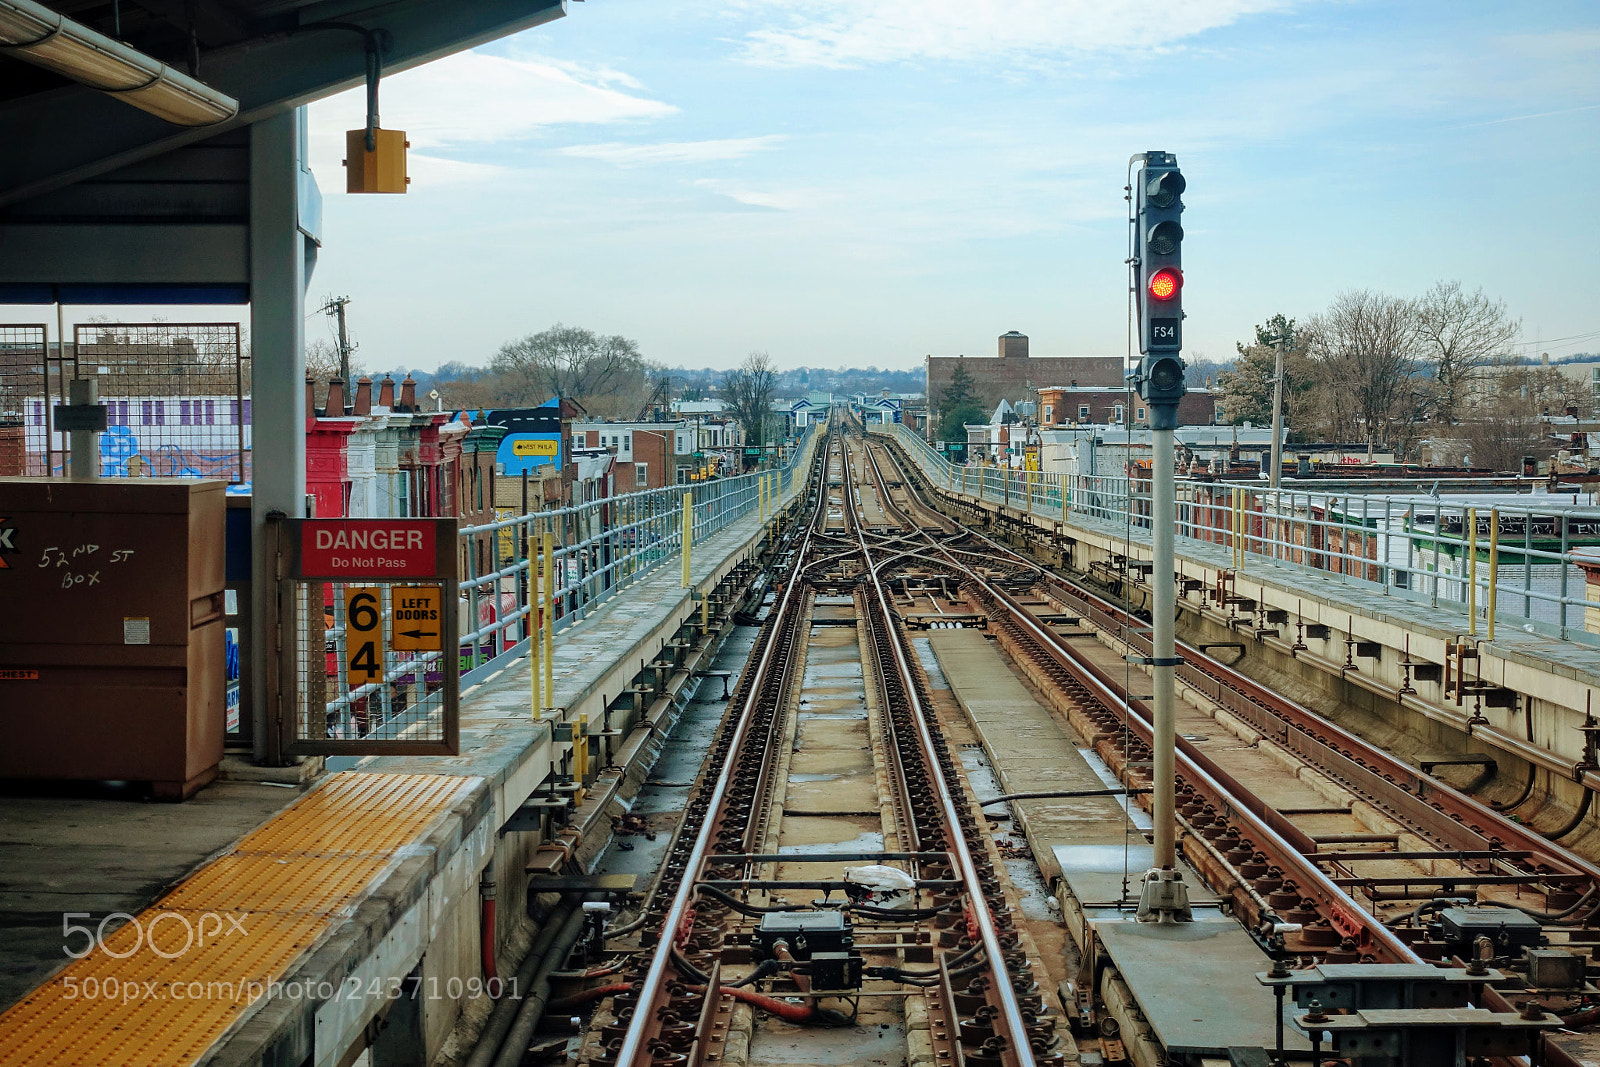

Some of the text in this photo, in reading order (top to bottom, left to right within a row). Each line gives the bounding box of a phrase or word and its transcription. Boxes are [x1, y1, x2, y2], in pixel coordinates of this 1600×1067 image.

[1154, 326, 1174, 338] FS4
[316, 529, 423, 550] DANGER
[110, 550, 135, 562] ST
[332, 557, 407, 568] Do Not Pass
[62, 571, 100, 589] BOX
[402, 598, 431, 609] LEFT
[348, 592, 378, 632] 6
[396, 610, 438, 621] DOORS
[350, 641, 380, 678] 4
